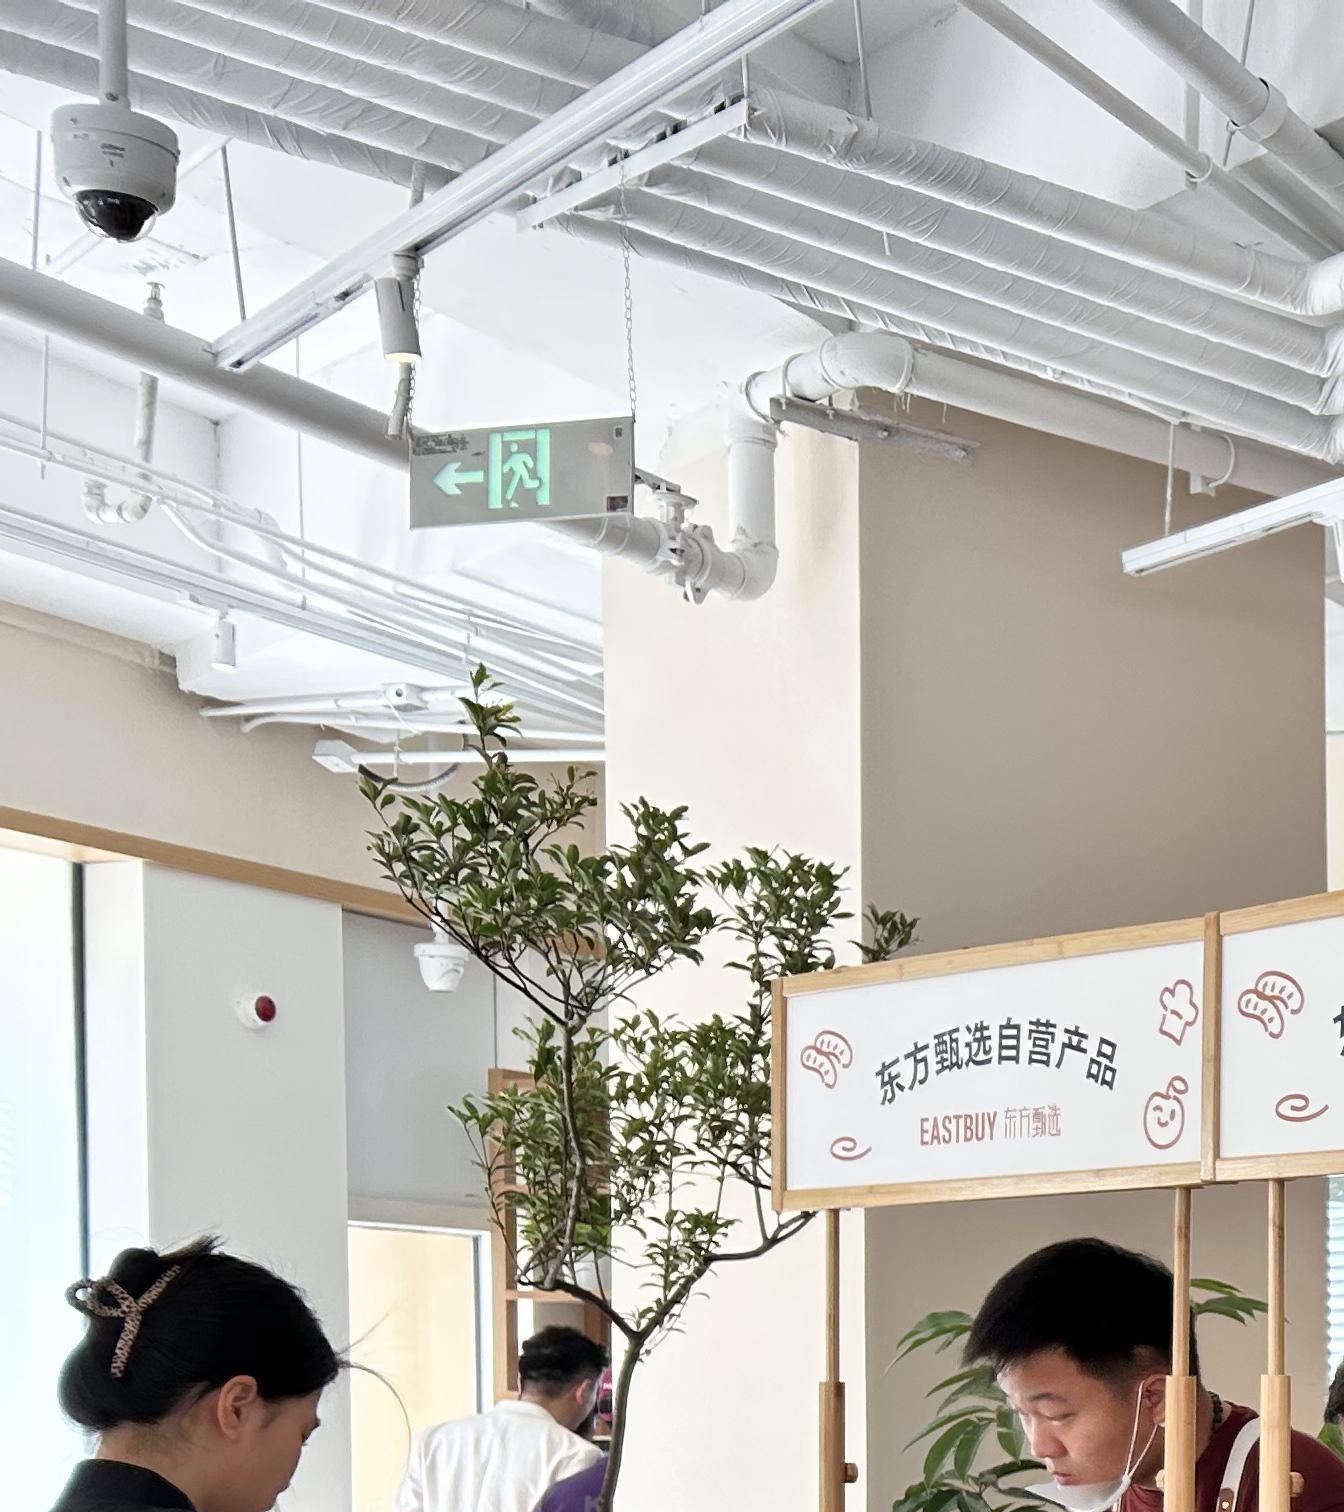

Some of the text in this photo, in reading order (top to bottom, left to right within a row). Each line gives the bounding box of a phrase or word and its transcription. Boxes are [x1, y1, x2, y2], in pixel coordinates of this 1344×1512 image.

[876, 1016, 1117, 1105] 东方甄选自营产品
[919, 1105, 1061, 1146] EASTBUY 东方甄选
